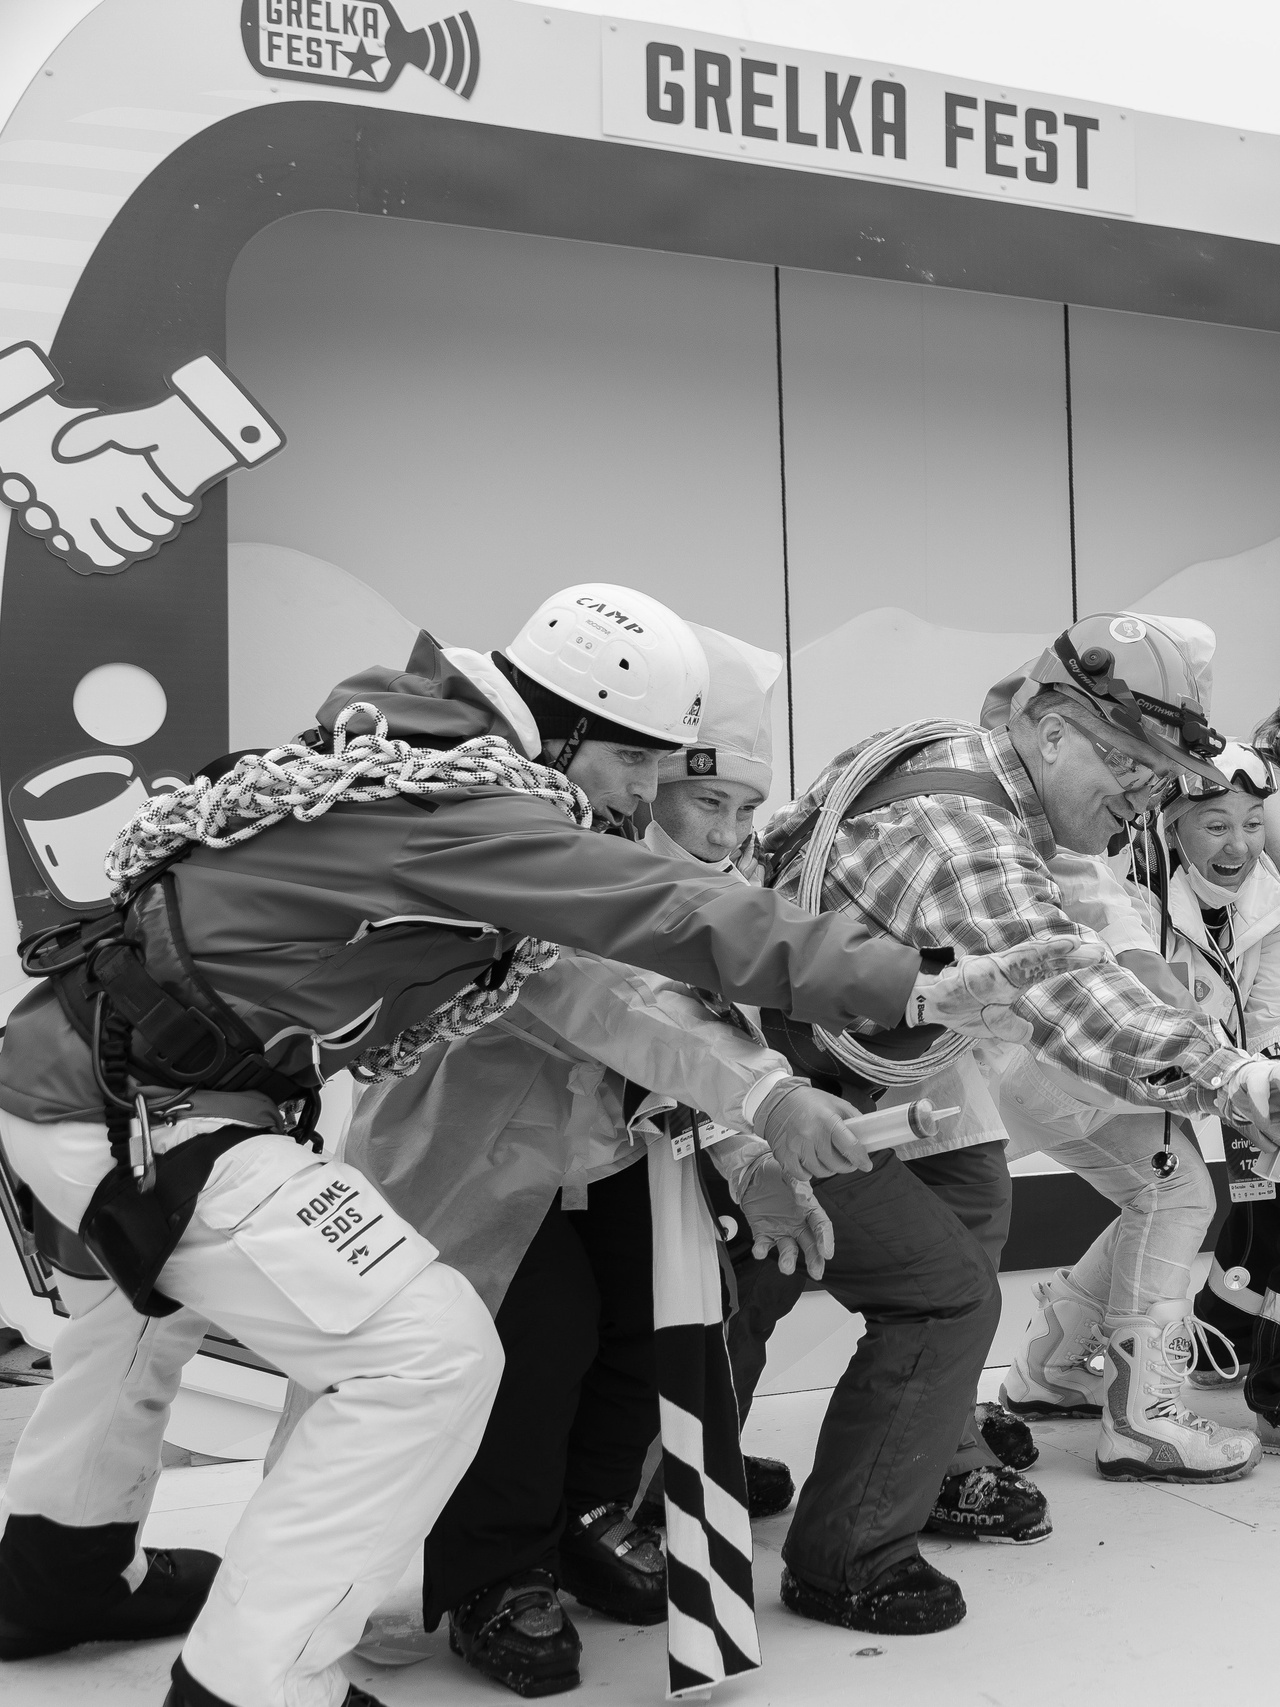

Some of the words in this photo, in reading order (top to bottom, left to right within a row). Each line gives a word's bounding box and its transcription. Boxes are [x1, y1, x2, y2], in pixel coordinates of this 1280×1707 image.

[266, 0, 379, 39] GRELKA
[267, 30, 343, 71] FEST
[646, 41, 907, 160] GRELKA
[944, 91, 1100, 190] FEST
[576, 597, 644, 634] CAMP
[1231, 1138, 1255, 1150] driv
[296, 1180, 351, 1226] ROME
[321, 1207, 363, 1243] SDS
